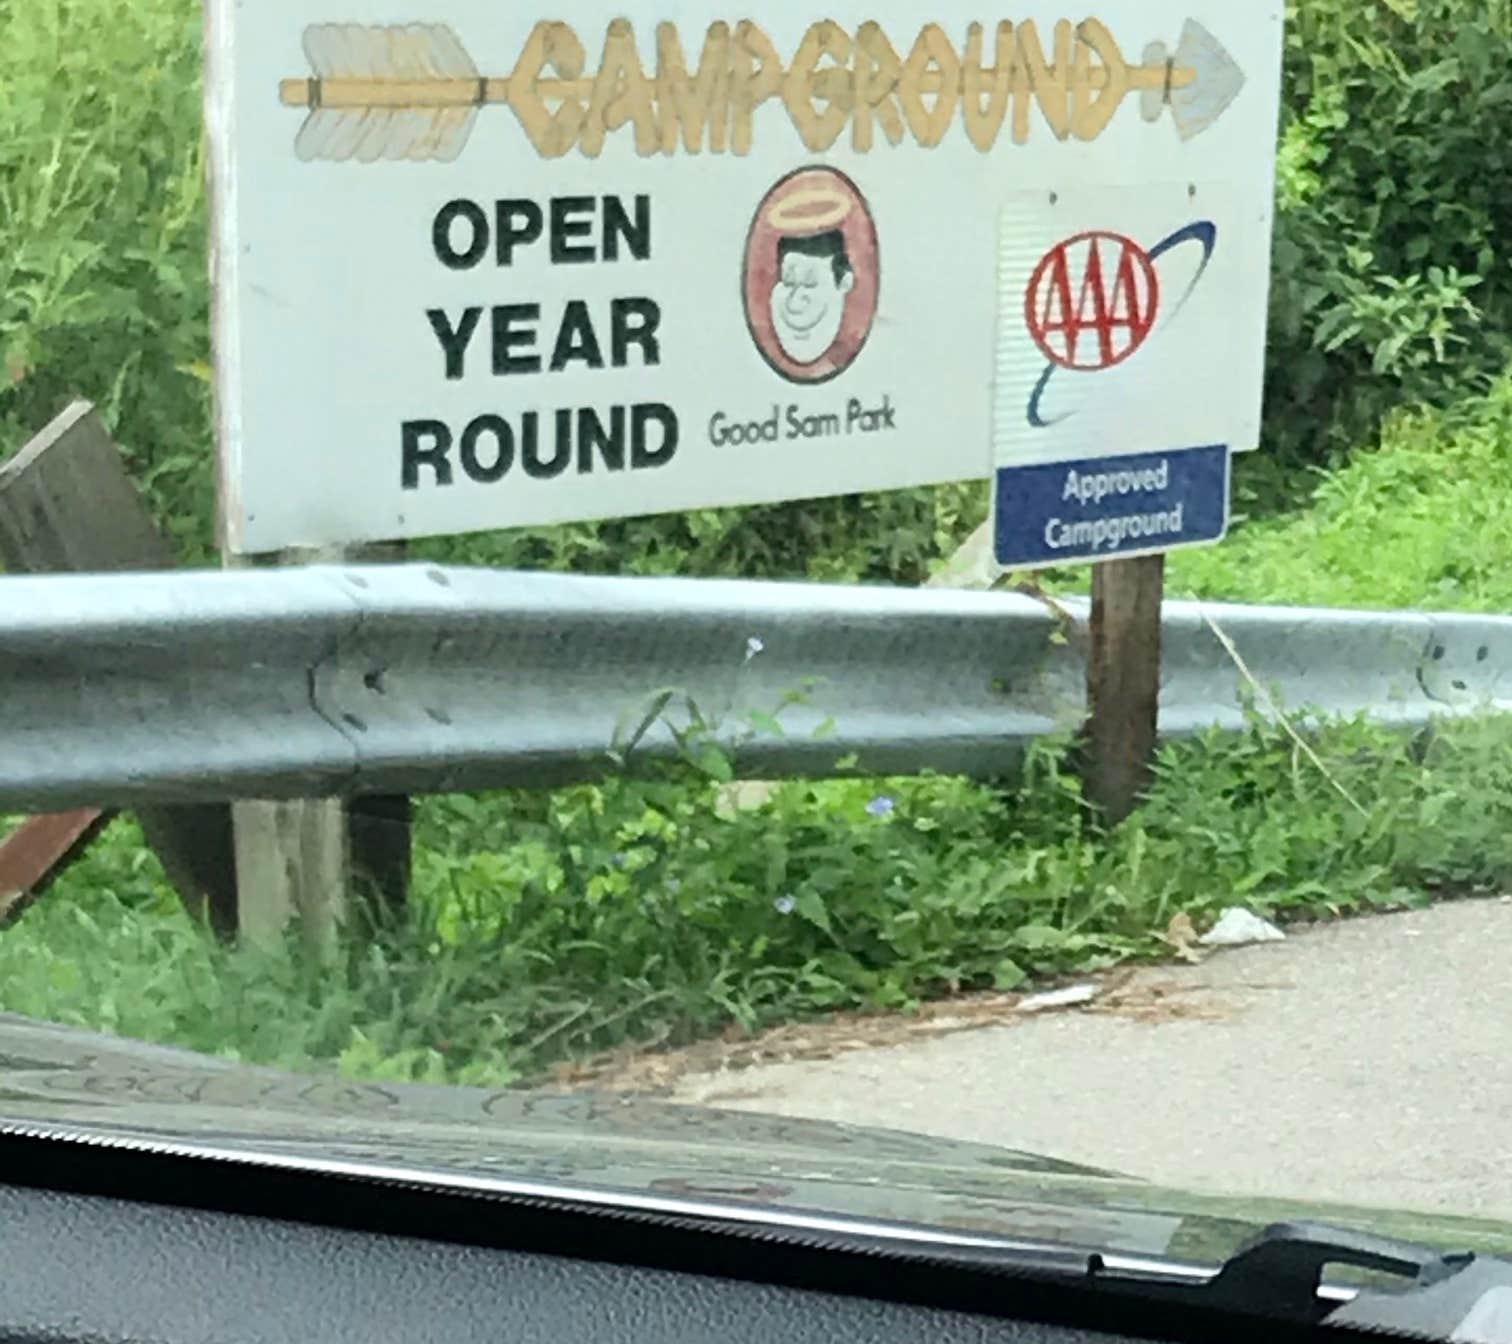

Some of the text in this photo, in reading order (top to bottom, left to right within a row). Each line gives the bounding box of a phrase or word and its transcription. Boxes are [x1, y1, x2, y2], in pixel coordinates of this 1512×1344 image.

[507, 18, 1129, 158] CAMPGROUND
[431, 194, 652, 271] OPEN
[426, 296, 661, 380] YEAR
[1036, 233, 1149, 367] AAA
[400, 402, 680, 490] ROUND
[708, 394, 896, 447] Good Sam Park
[1062, 458, 1169, 505] Approved
[1044, 504, 1184, 550] Campground
